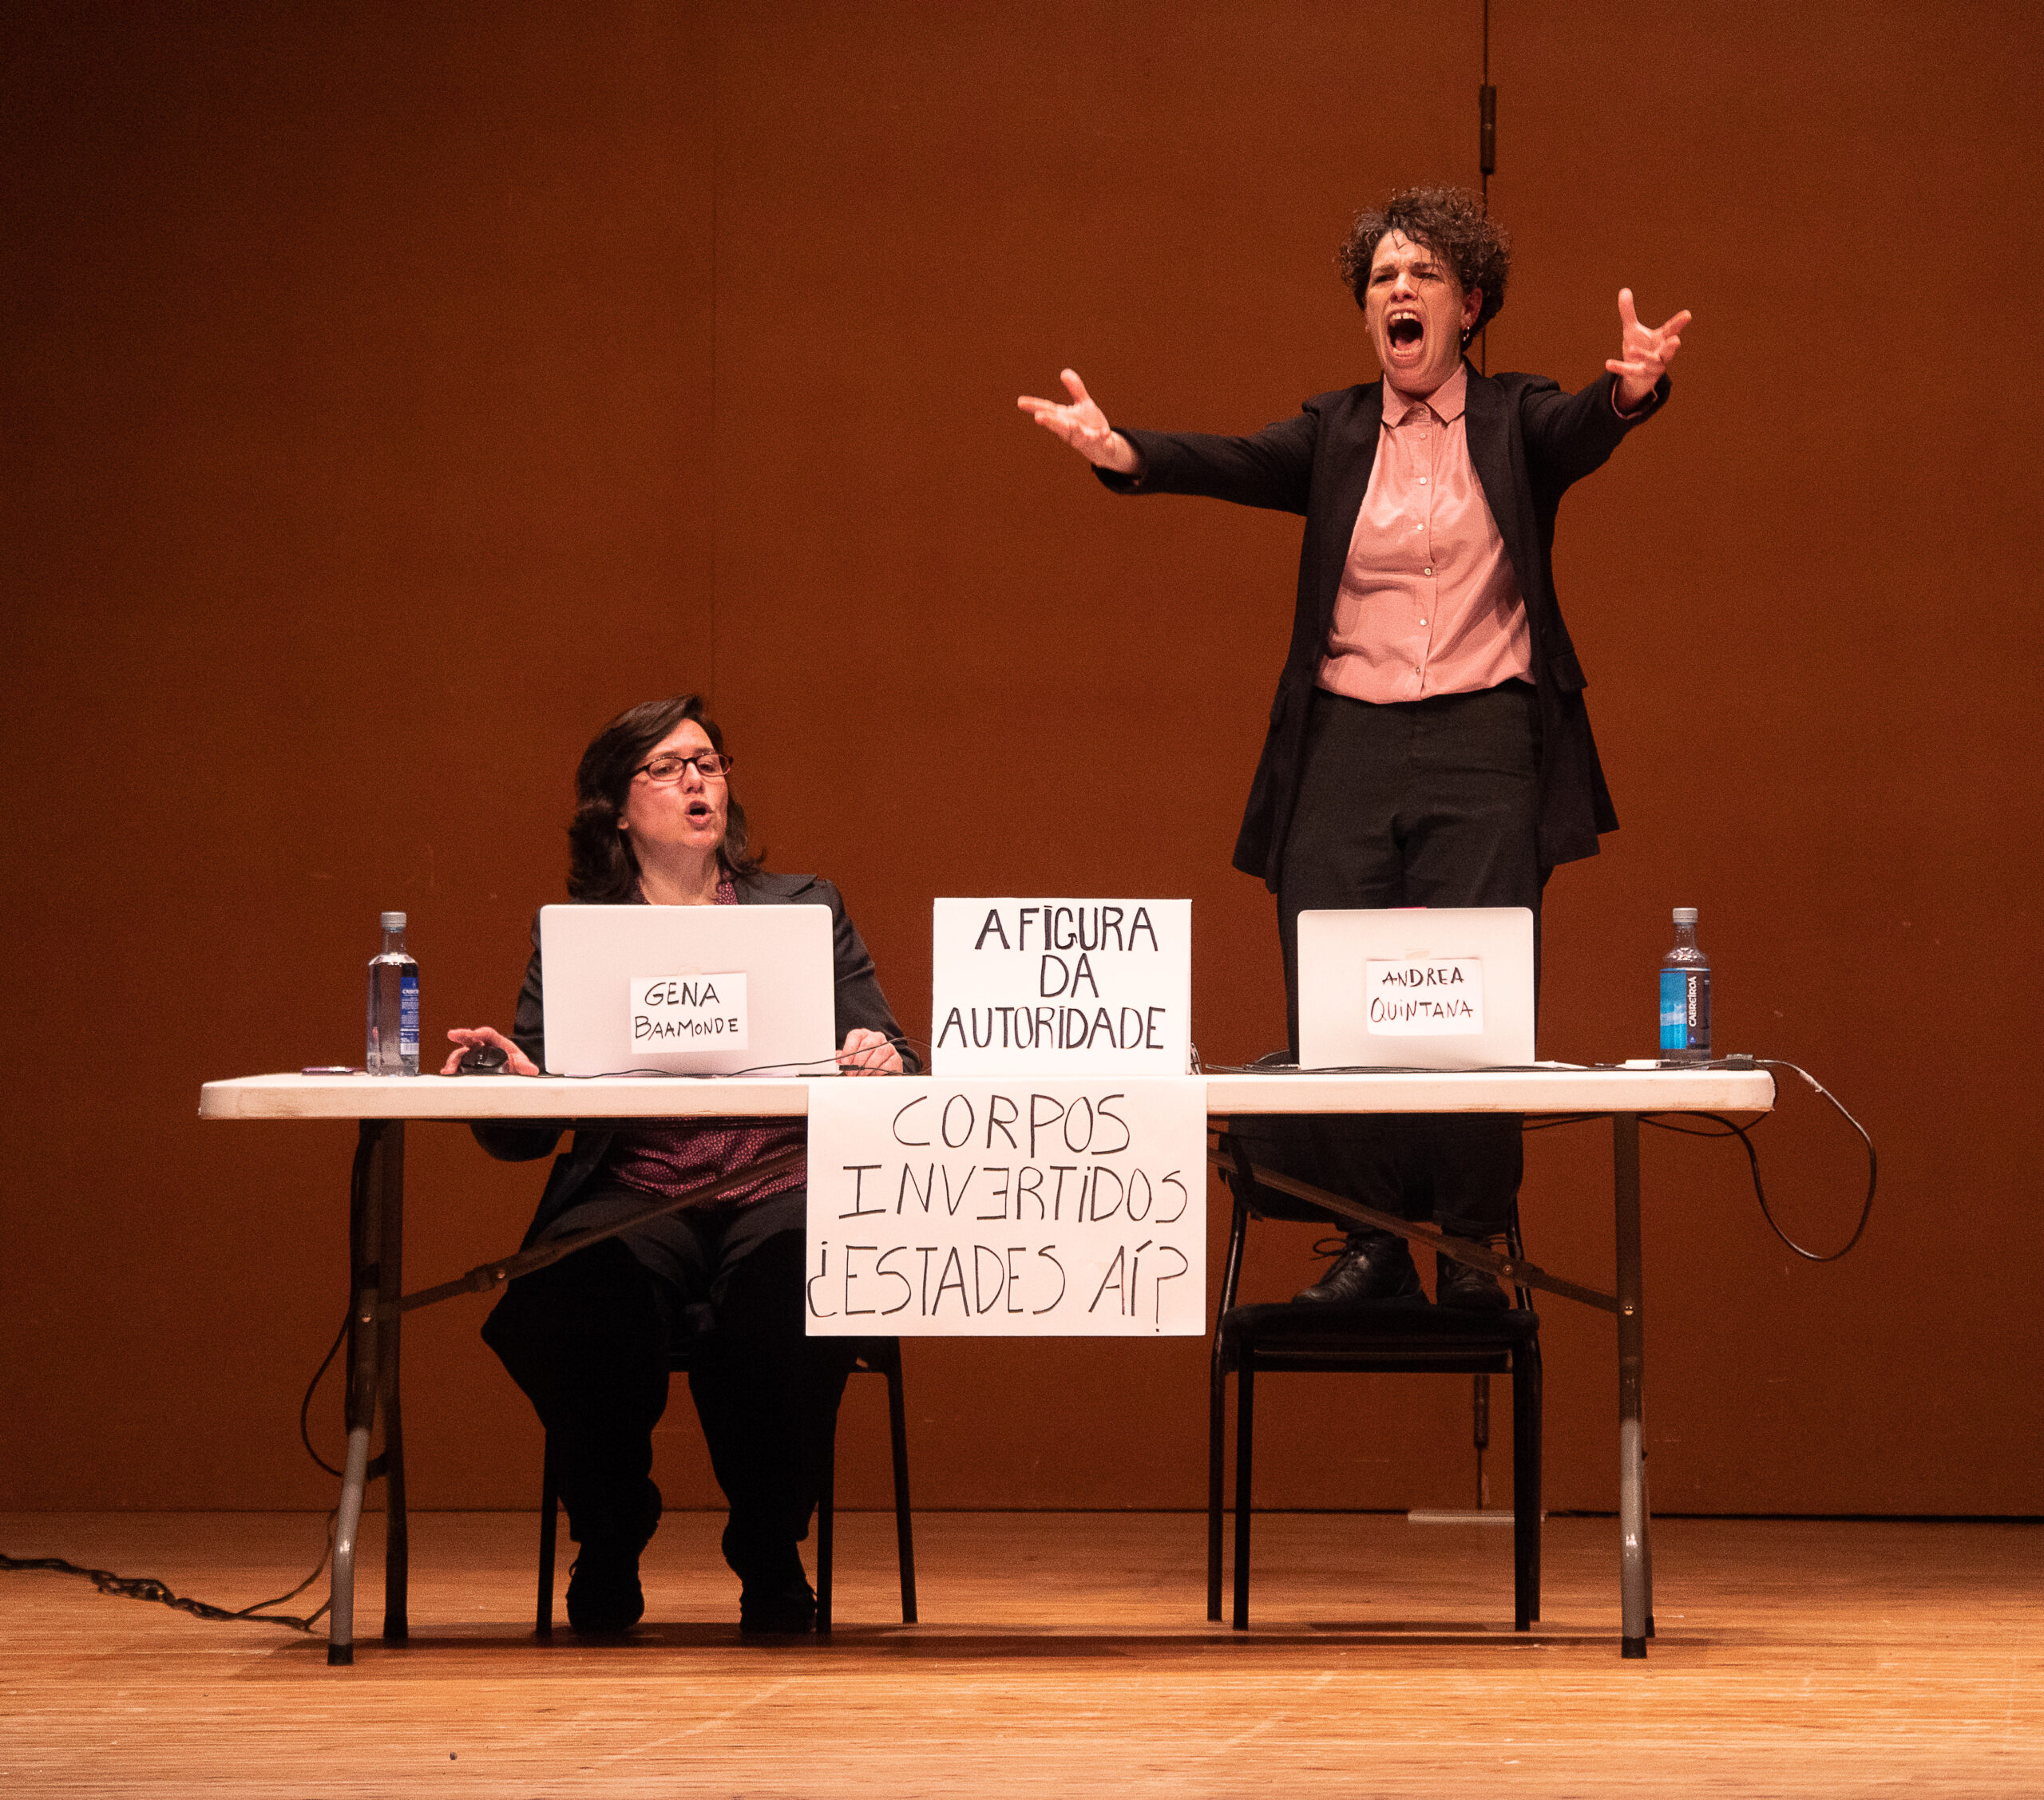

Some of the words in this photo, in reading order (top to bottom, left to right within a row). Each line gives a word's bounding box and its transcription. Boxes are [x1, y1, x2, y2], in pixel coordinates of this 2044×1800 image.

[975, 908, 1010, 950] A
[1020, 904, 1158, 951] FIGURA
[644, 982, 720, 1007] GENA
[1040, 953, 1099, 998] DA
[1382, 967, 1464, 987] ANDREA
[635, 1015, 739, 1041] BAAMONDE
[937, 1006, 1166, 1049] AUTORIDADE
[893, 1094, 1130, 1157] CORPOS
[806, 1240, 1066, 1318] ¿ESTADES
[1088, 1239, 1189, 1332] AÍ?
